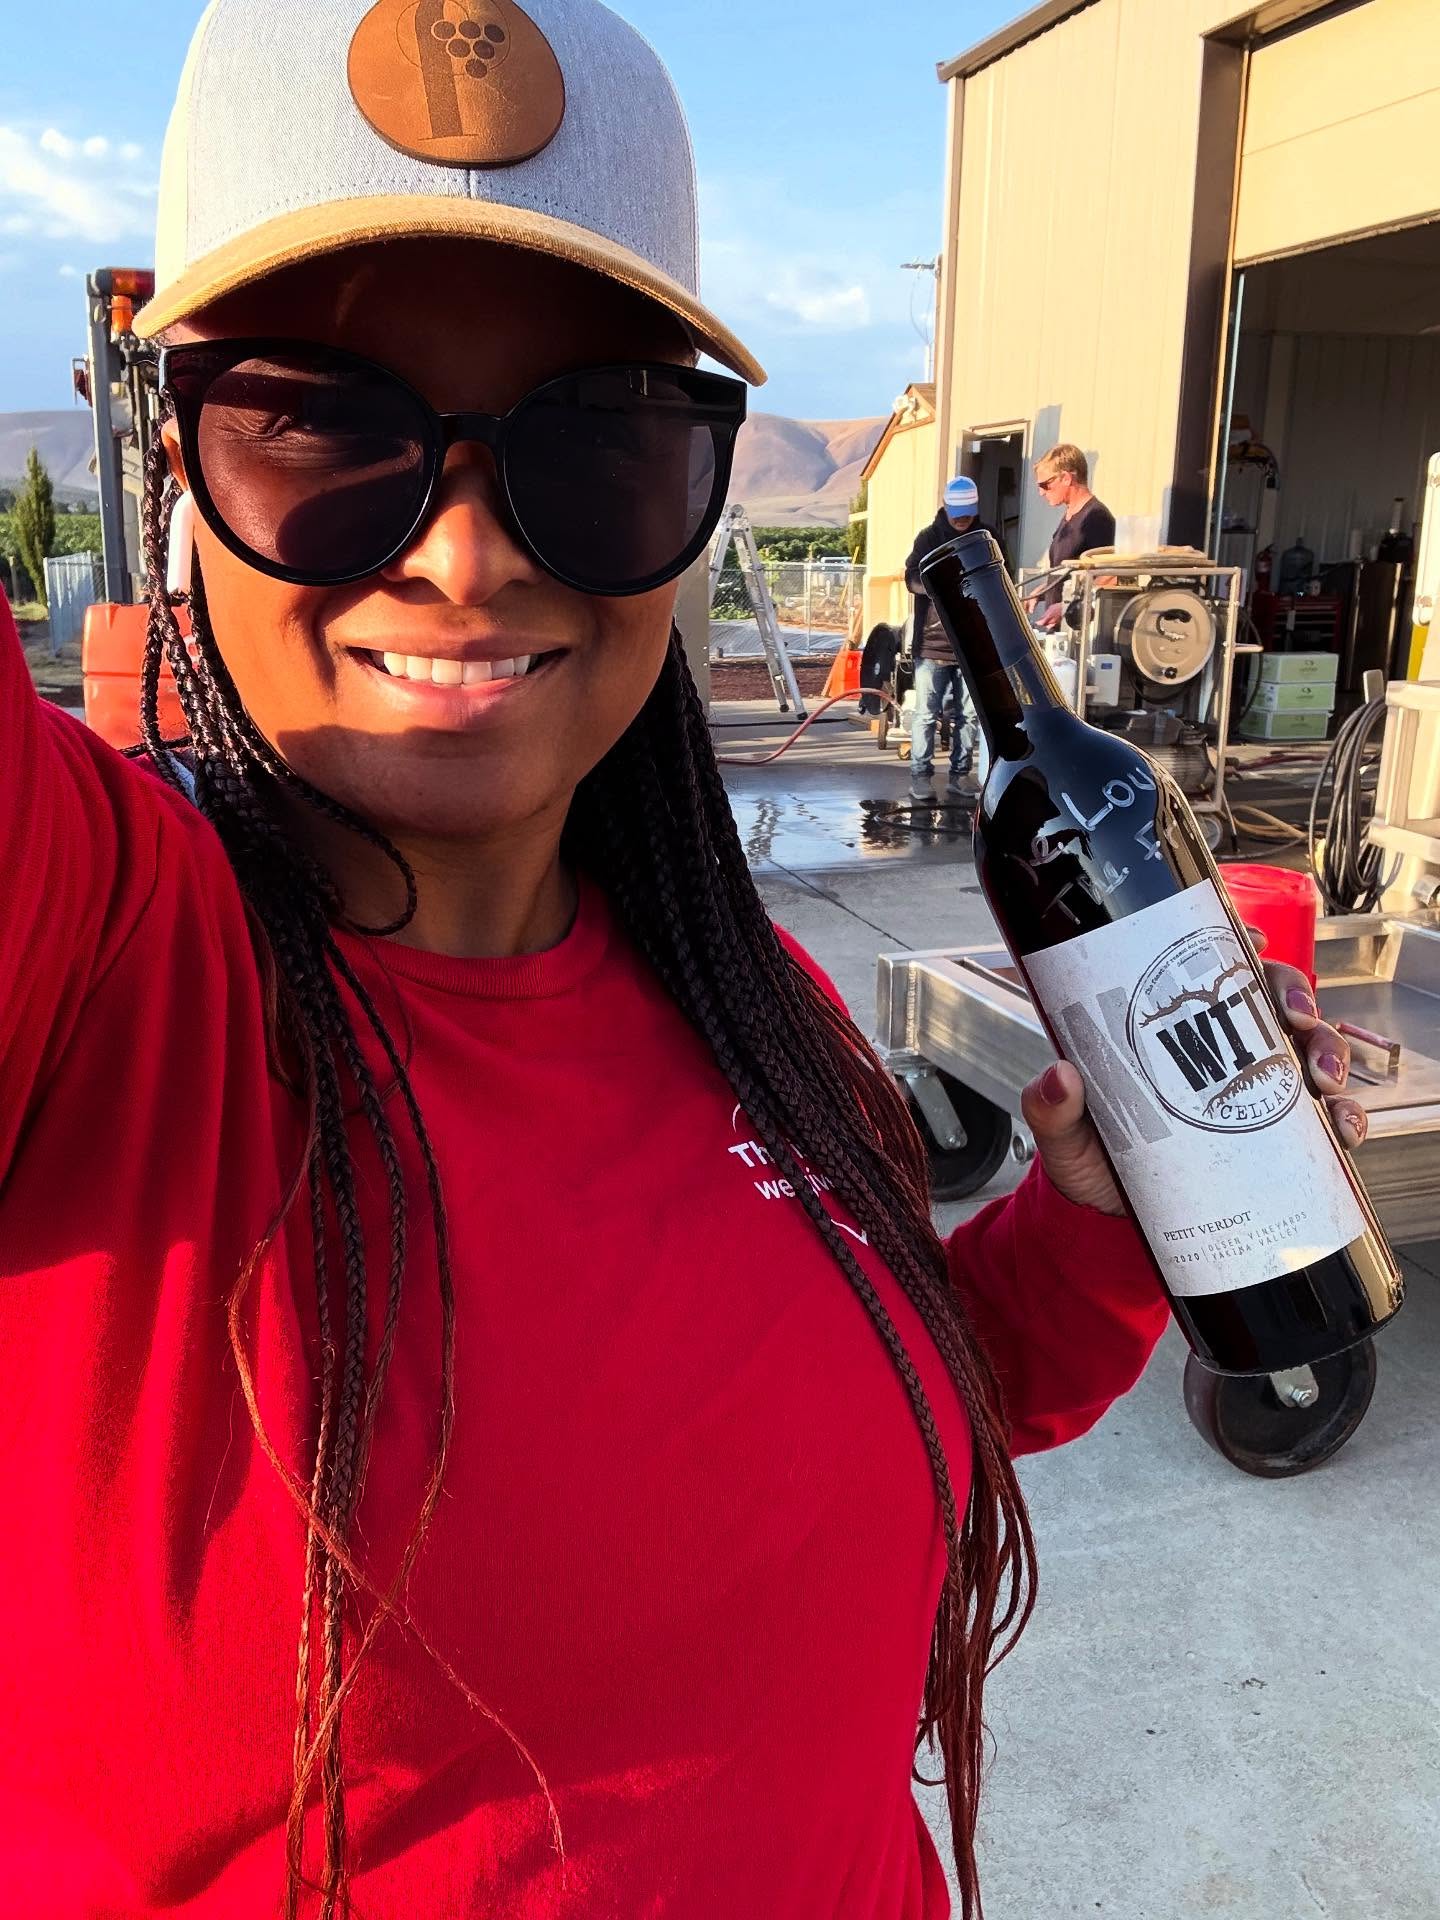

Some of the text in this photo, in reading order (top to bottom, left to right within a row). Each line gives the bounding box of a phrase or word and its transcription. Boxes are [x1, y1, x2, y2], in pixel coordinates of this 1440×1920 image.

[1220, 1068, 1295, 1121] CELLARS
[727, 1140, 777, 1168] Th
[754, 1178, 796, 1200] we
[1163, 1211, 1252, 1242] PETIT VERDOT
[1208, 1211, 1309, 1252] OLSEN VINEYARDS
[1259, 1226, 1299, 1247] VALLEY
[1173, 1252, 1200, 1264] 2020
